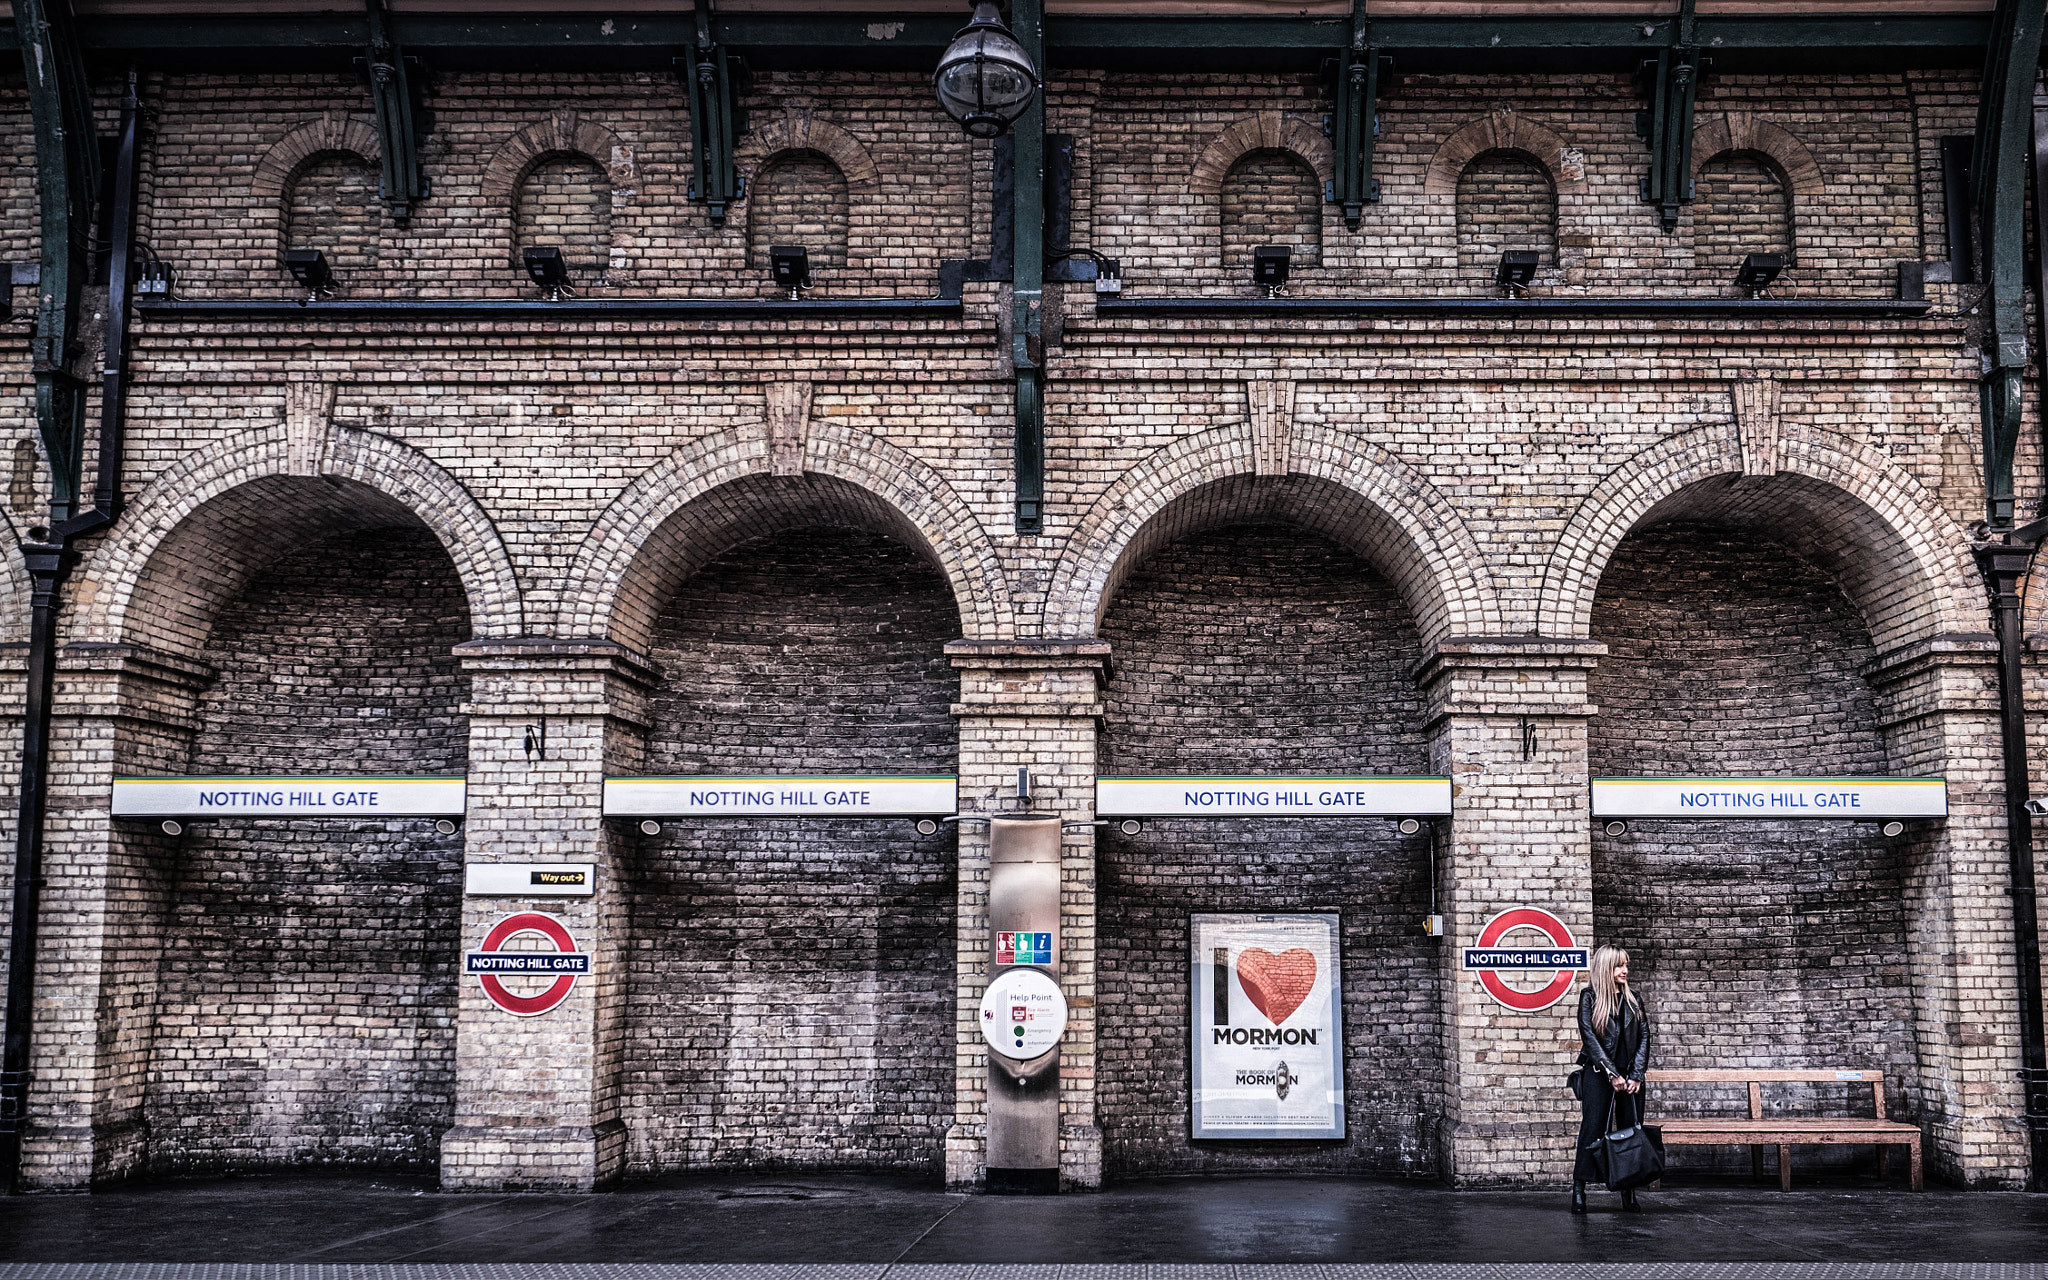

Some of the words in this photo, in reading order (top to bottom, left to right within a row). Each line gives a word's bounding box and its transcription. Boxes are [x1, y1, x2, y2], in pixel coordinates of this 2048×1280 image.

[200, 791, 284, 806] NOTTING
[289, 791, 326, 806] HILL
[332, 791, 379, 806] GATE
[690, 791, 775, 806] NOTTING
[781, 791, 818, 806] HILL
[823, 791, 870, 806] GATE
[1185, 791, 1269, 806] NOTTING
[1275, 791, 1313, 806] HILL
[1318, 791, 1366, 806] GATE
[1680, 792, 1765, 807] NOTTING
[1771, 792, 1809, 807] HILL
[1814, 792, 1861, 807] GATE
[540, 873, 559, 883] Way
[560, 874, 575, 882] out
[471, 958, 525, 969] NOTTING
[526, 958, 551, 969] HILL
[553, 958, 584, 969] GATE
[1469, 953, 1523, 964] NOTTING
[1525, 953, 1549, 964] HILL
[1551, 953, 1582, 964] GATE
[1010, 993, 1030, 1002] Help
[1031, 993, 1053, 1001] Point
